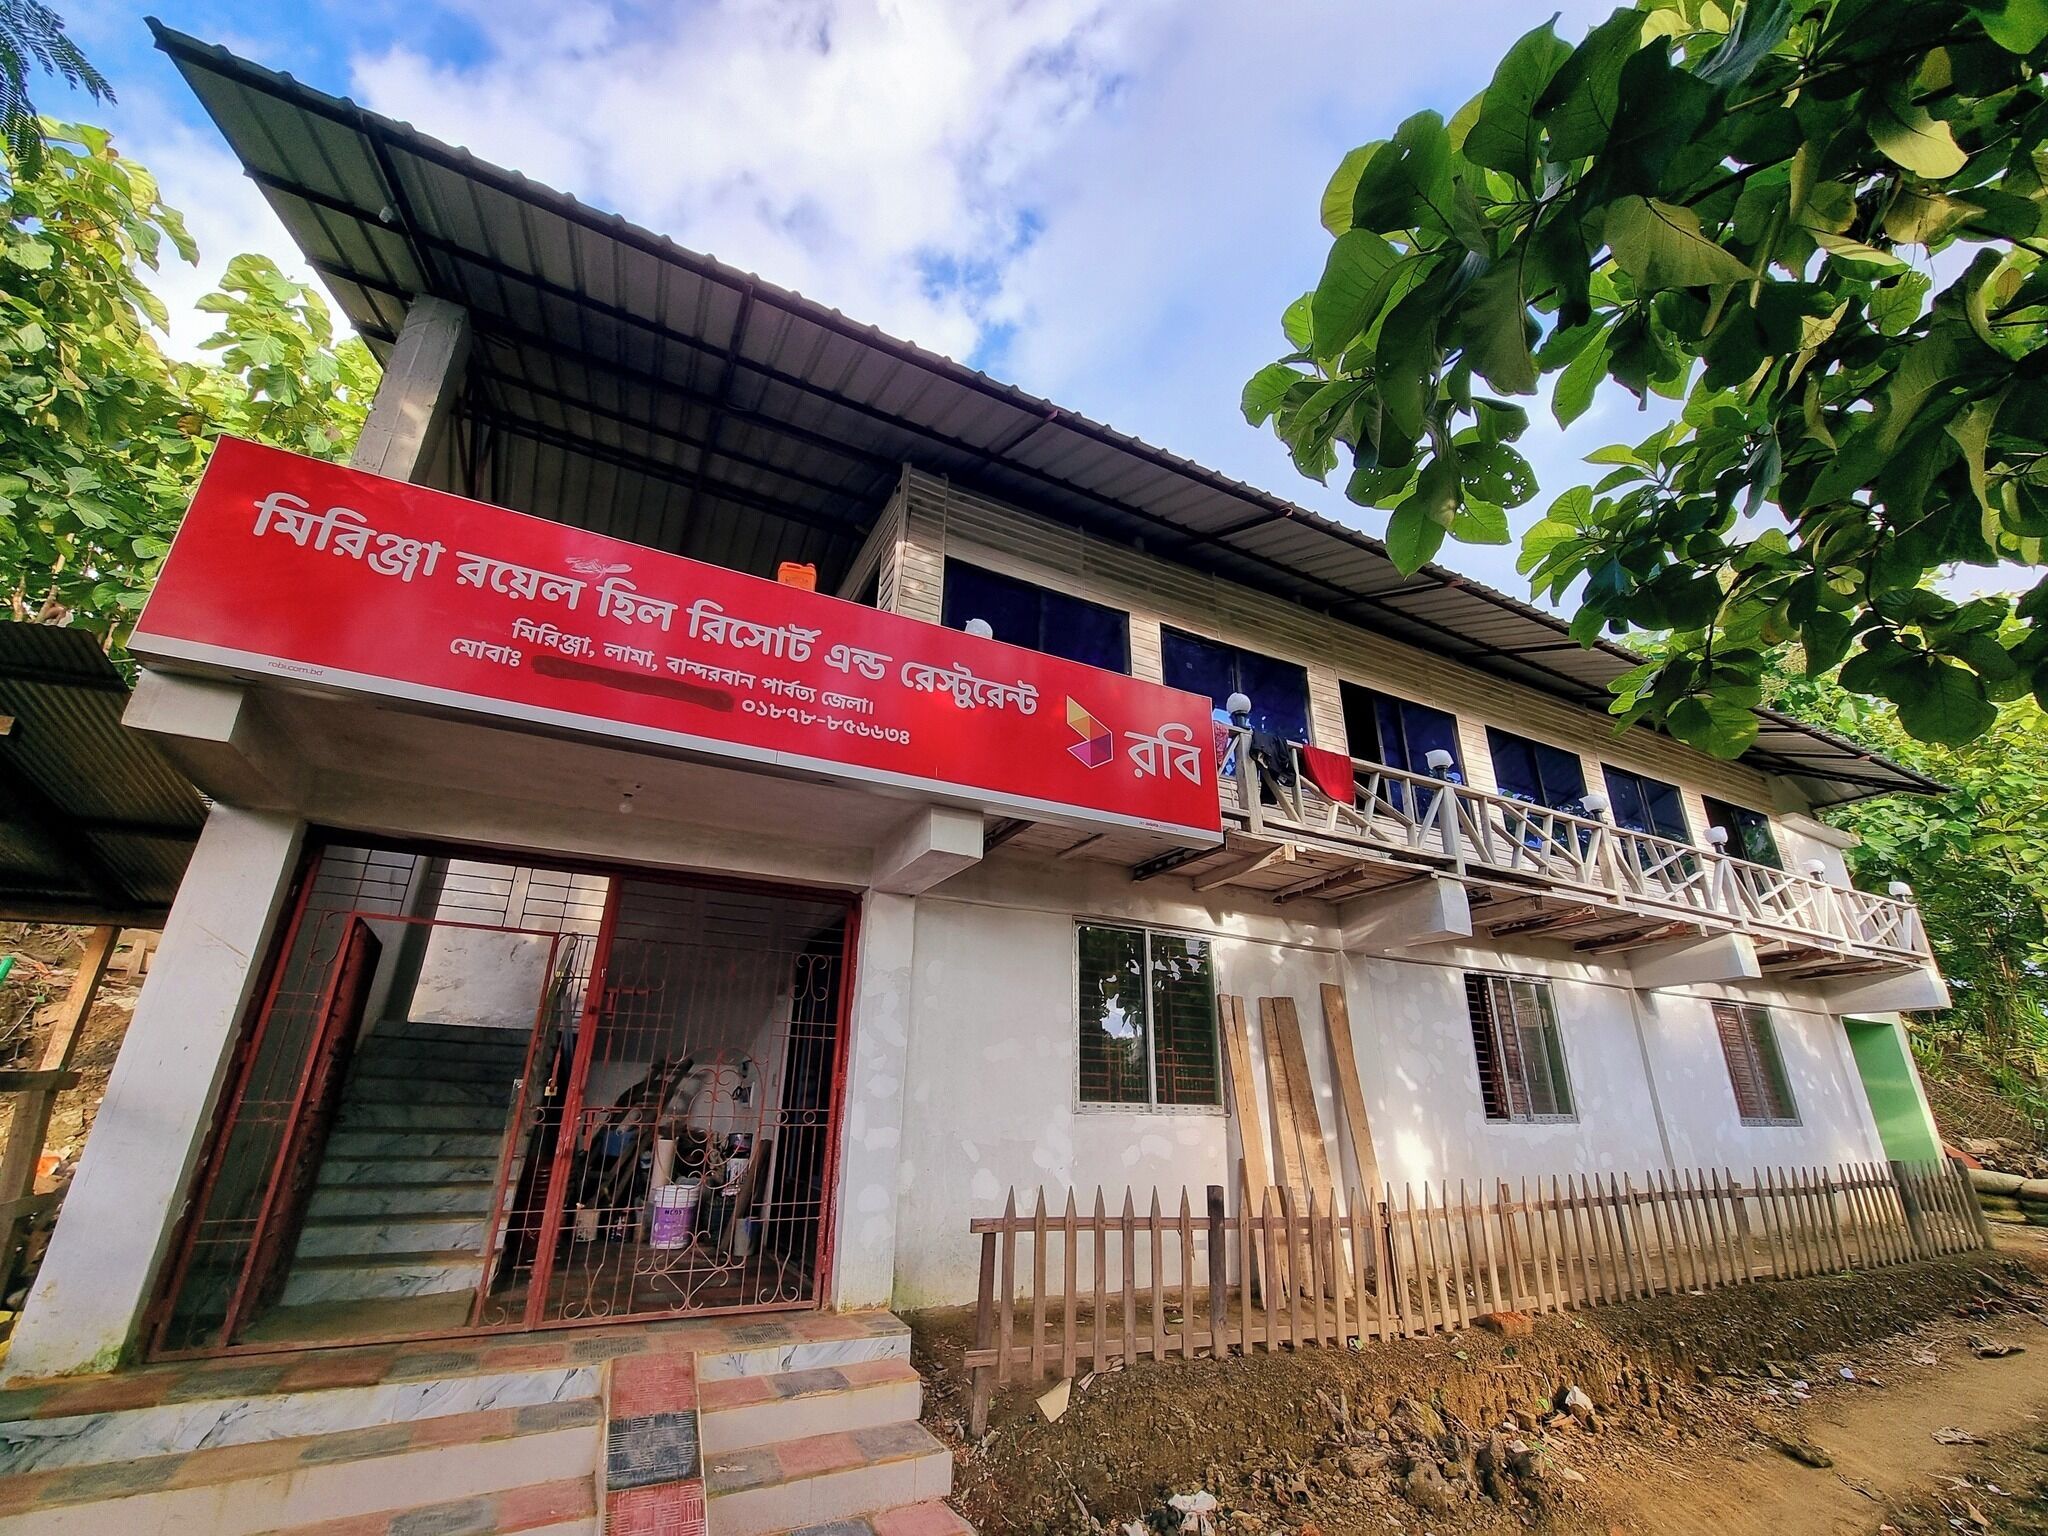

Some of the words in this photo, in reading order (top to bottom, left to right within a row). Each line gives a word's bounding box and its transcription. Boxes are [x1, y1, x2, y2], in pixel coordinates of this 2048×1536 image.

[253, 492, 446, 582] মিরিঞ্জা
[456, 551, 587, 610] রয়েল
[596, 577, 678, 631] হিল
[686, 599, 822, 662] রিসোর্ট
[824, 644, 893, 680] এন্ড
[901, 662, 1039, 715] রেস্টুরেন্ট
[268, 661, 323, 676] robi.com.bd
[450, 638, 522, 667] মোবাঃ
[742, 699, 910, 745] ০১৮৭৮-৮৫৬৬৩৪
[512, 618, 595, 658] মিরিঞ্জা,
[603, 642, 658, 671] লামা,
[666, 656, 756, 690] বান্দরবান
[762, 677, 817, 704] পার্বত্য
[821, 691, 874, 714] জেলা।
[1124, 723, 1201, 786] রবি
